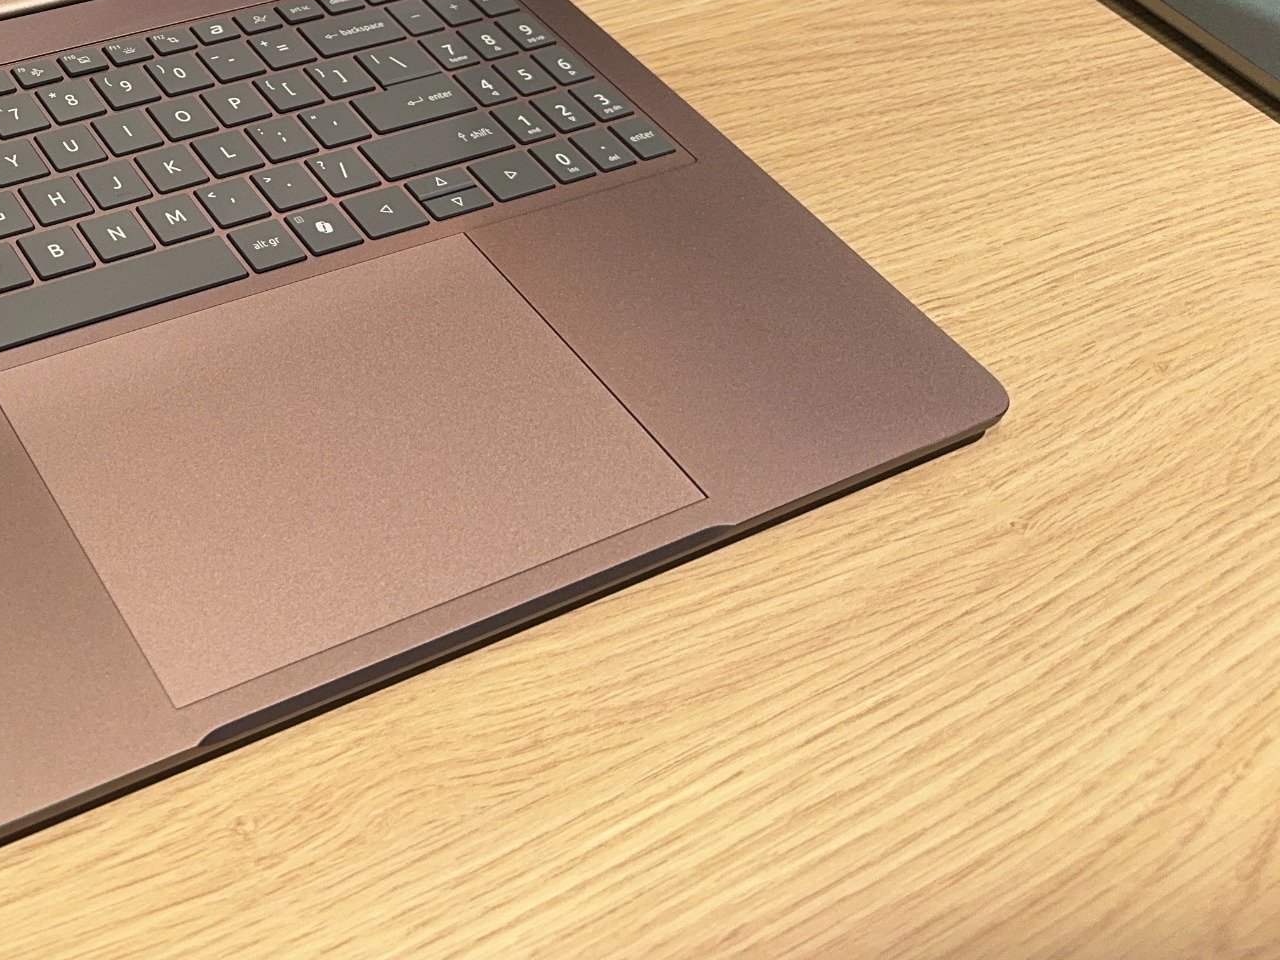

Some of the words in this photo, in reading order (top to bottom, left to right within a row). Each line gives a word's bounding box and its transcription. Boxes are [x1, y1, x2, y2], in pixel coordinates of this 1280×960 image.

[338, 20, 385, 38] backspace
[427, 88, 453, 103] enter
[469, 126, 493, 142] shift
